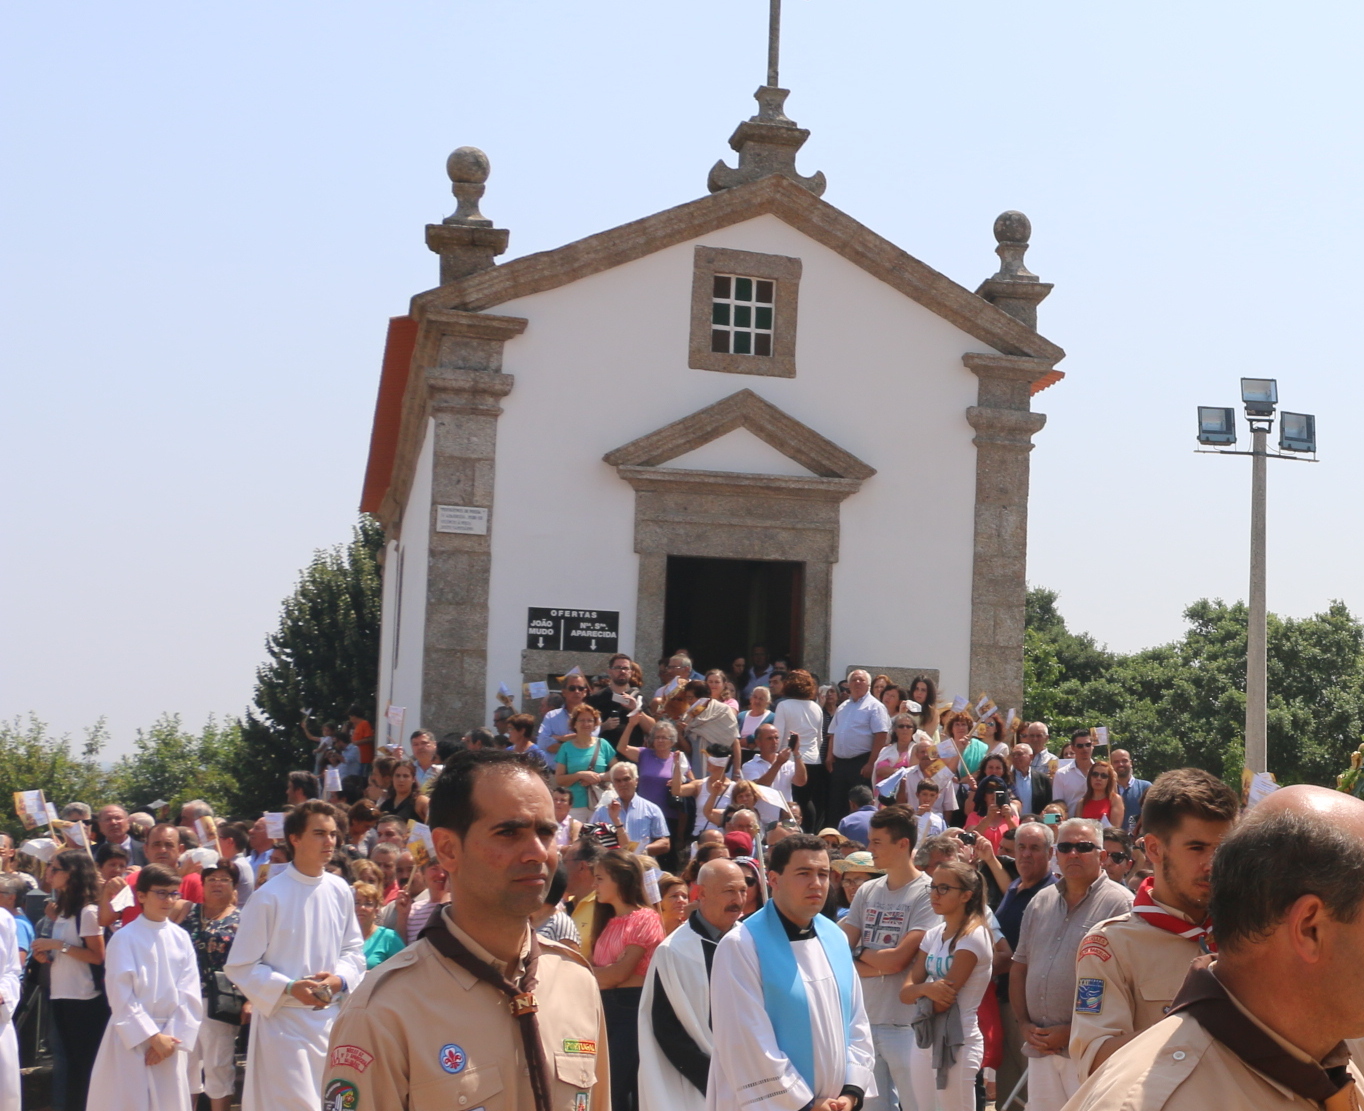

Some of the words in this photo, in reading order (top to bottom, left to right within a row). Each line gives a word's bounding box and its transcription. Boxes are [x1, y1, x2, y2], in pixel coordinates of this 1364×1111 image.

[550, 610, 598, 619] OFERTAS
[530, 618, 553, 628] JOÃO
[570, 630, 617, 638] APARECIDA
